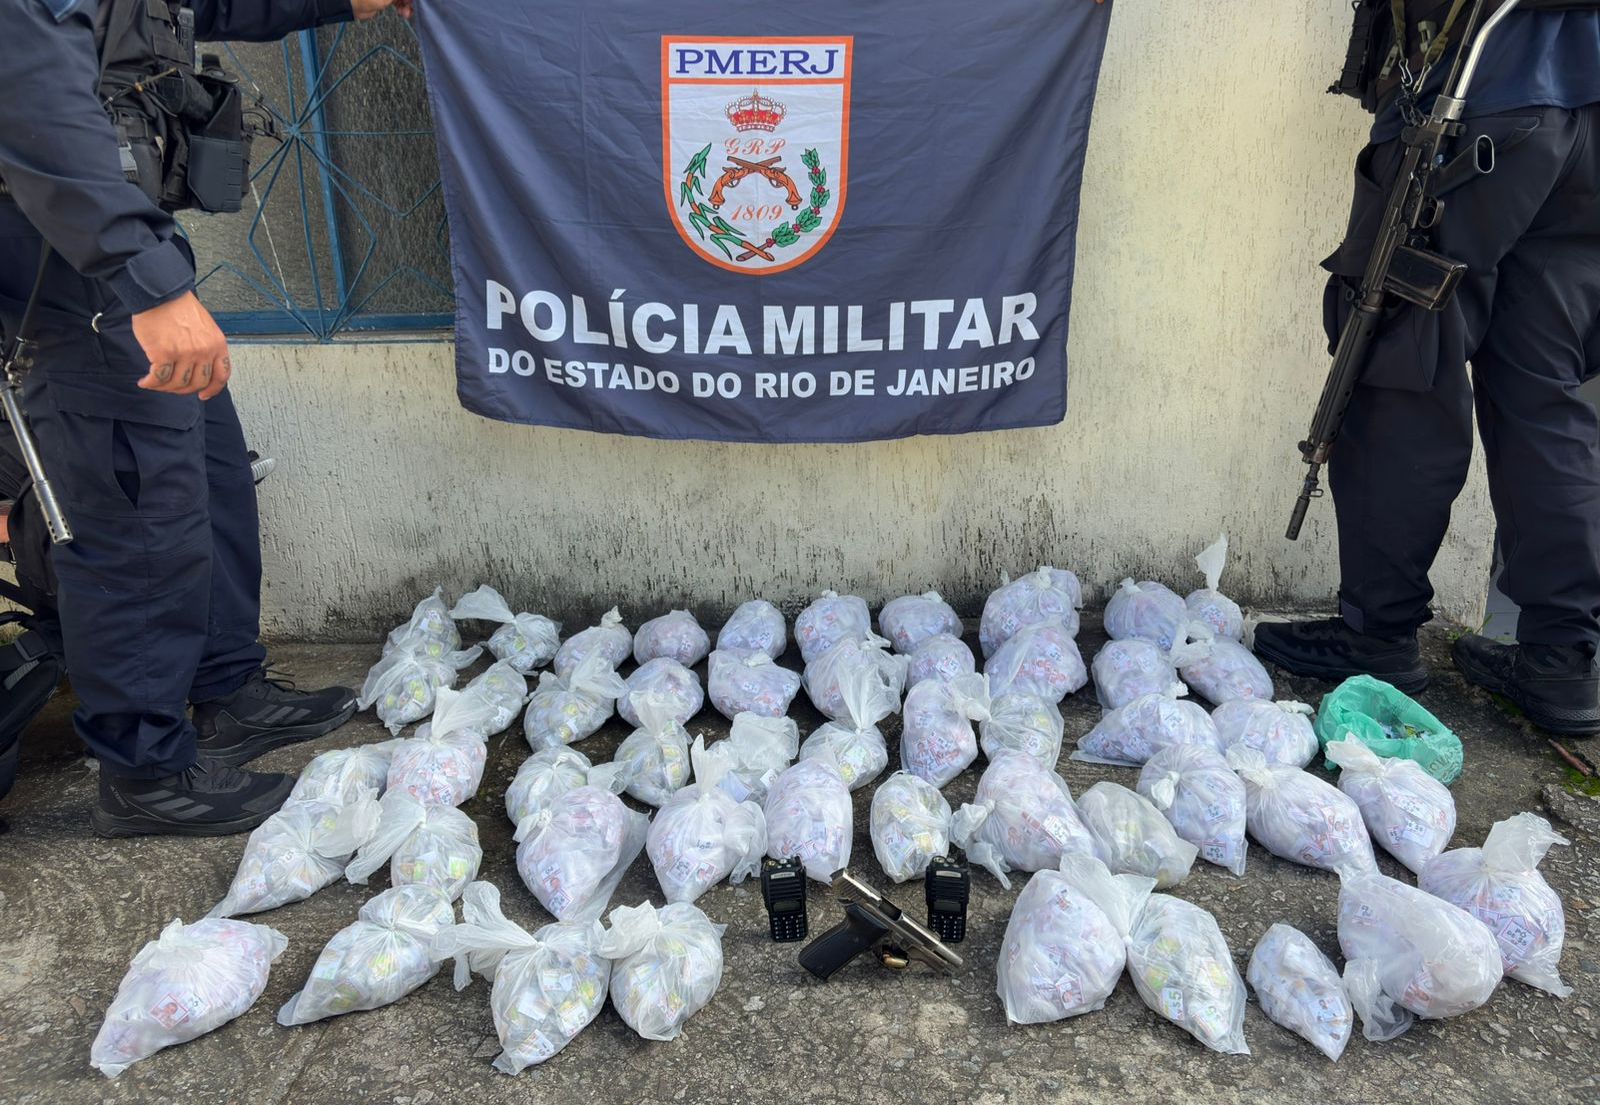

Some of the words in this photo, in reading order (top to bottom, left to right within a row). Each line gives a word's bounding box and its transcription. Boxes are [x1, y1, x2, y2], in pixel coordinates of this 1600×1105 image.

[675, 48, 839, 75] PMERJ
[724, 138, 786, 156] GRP
[729, 204, 784, 221] 1809
[486, 278, 753, 356] POLÍCIA
[763, 292, 1041, 355] MILITAR
[487, 347, 536, 377] DO
[543, 357, 680, 394] ESTADO
[692, 372, 742, 399] DO
[755, 371, 817, 399] RIO
[829, 369, 876, 396] DE
[886, 356, 1036, 397] JANEIRO
